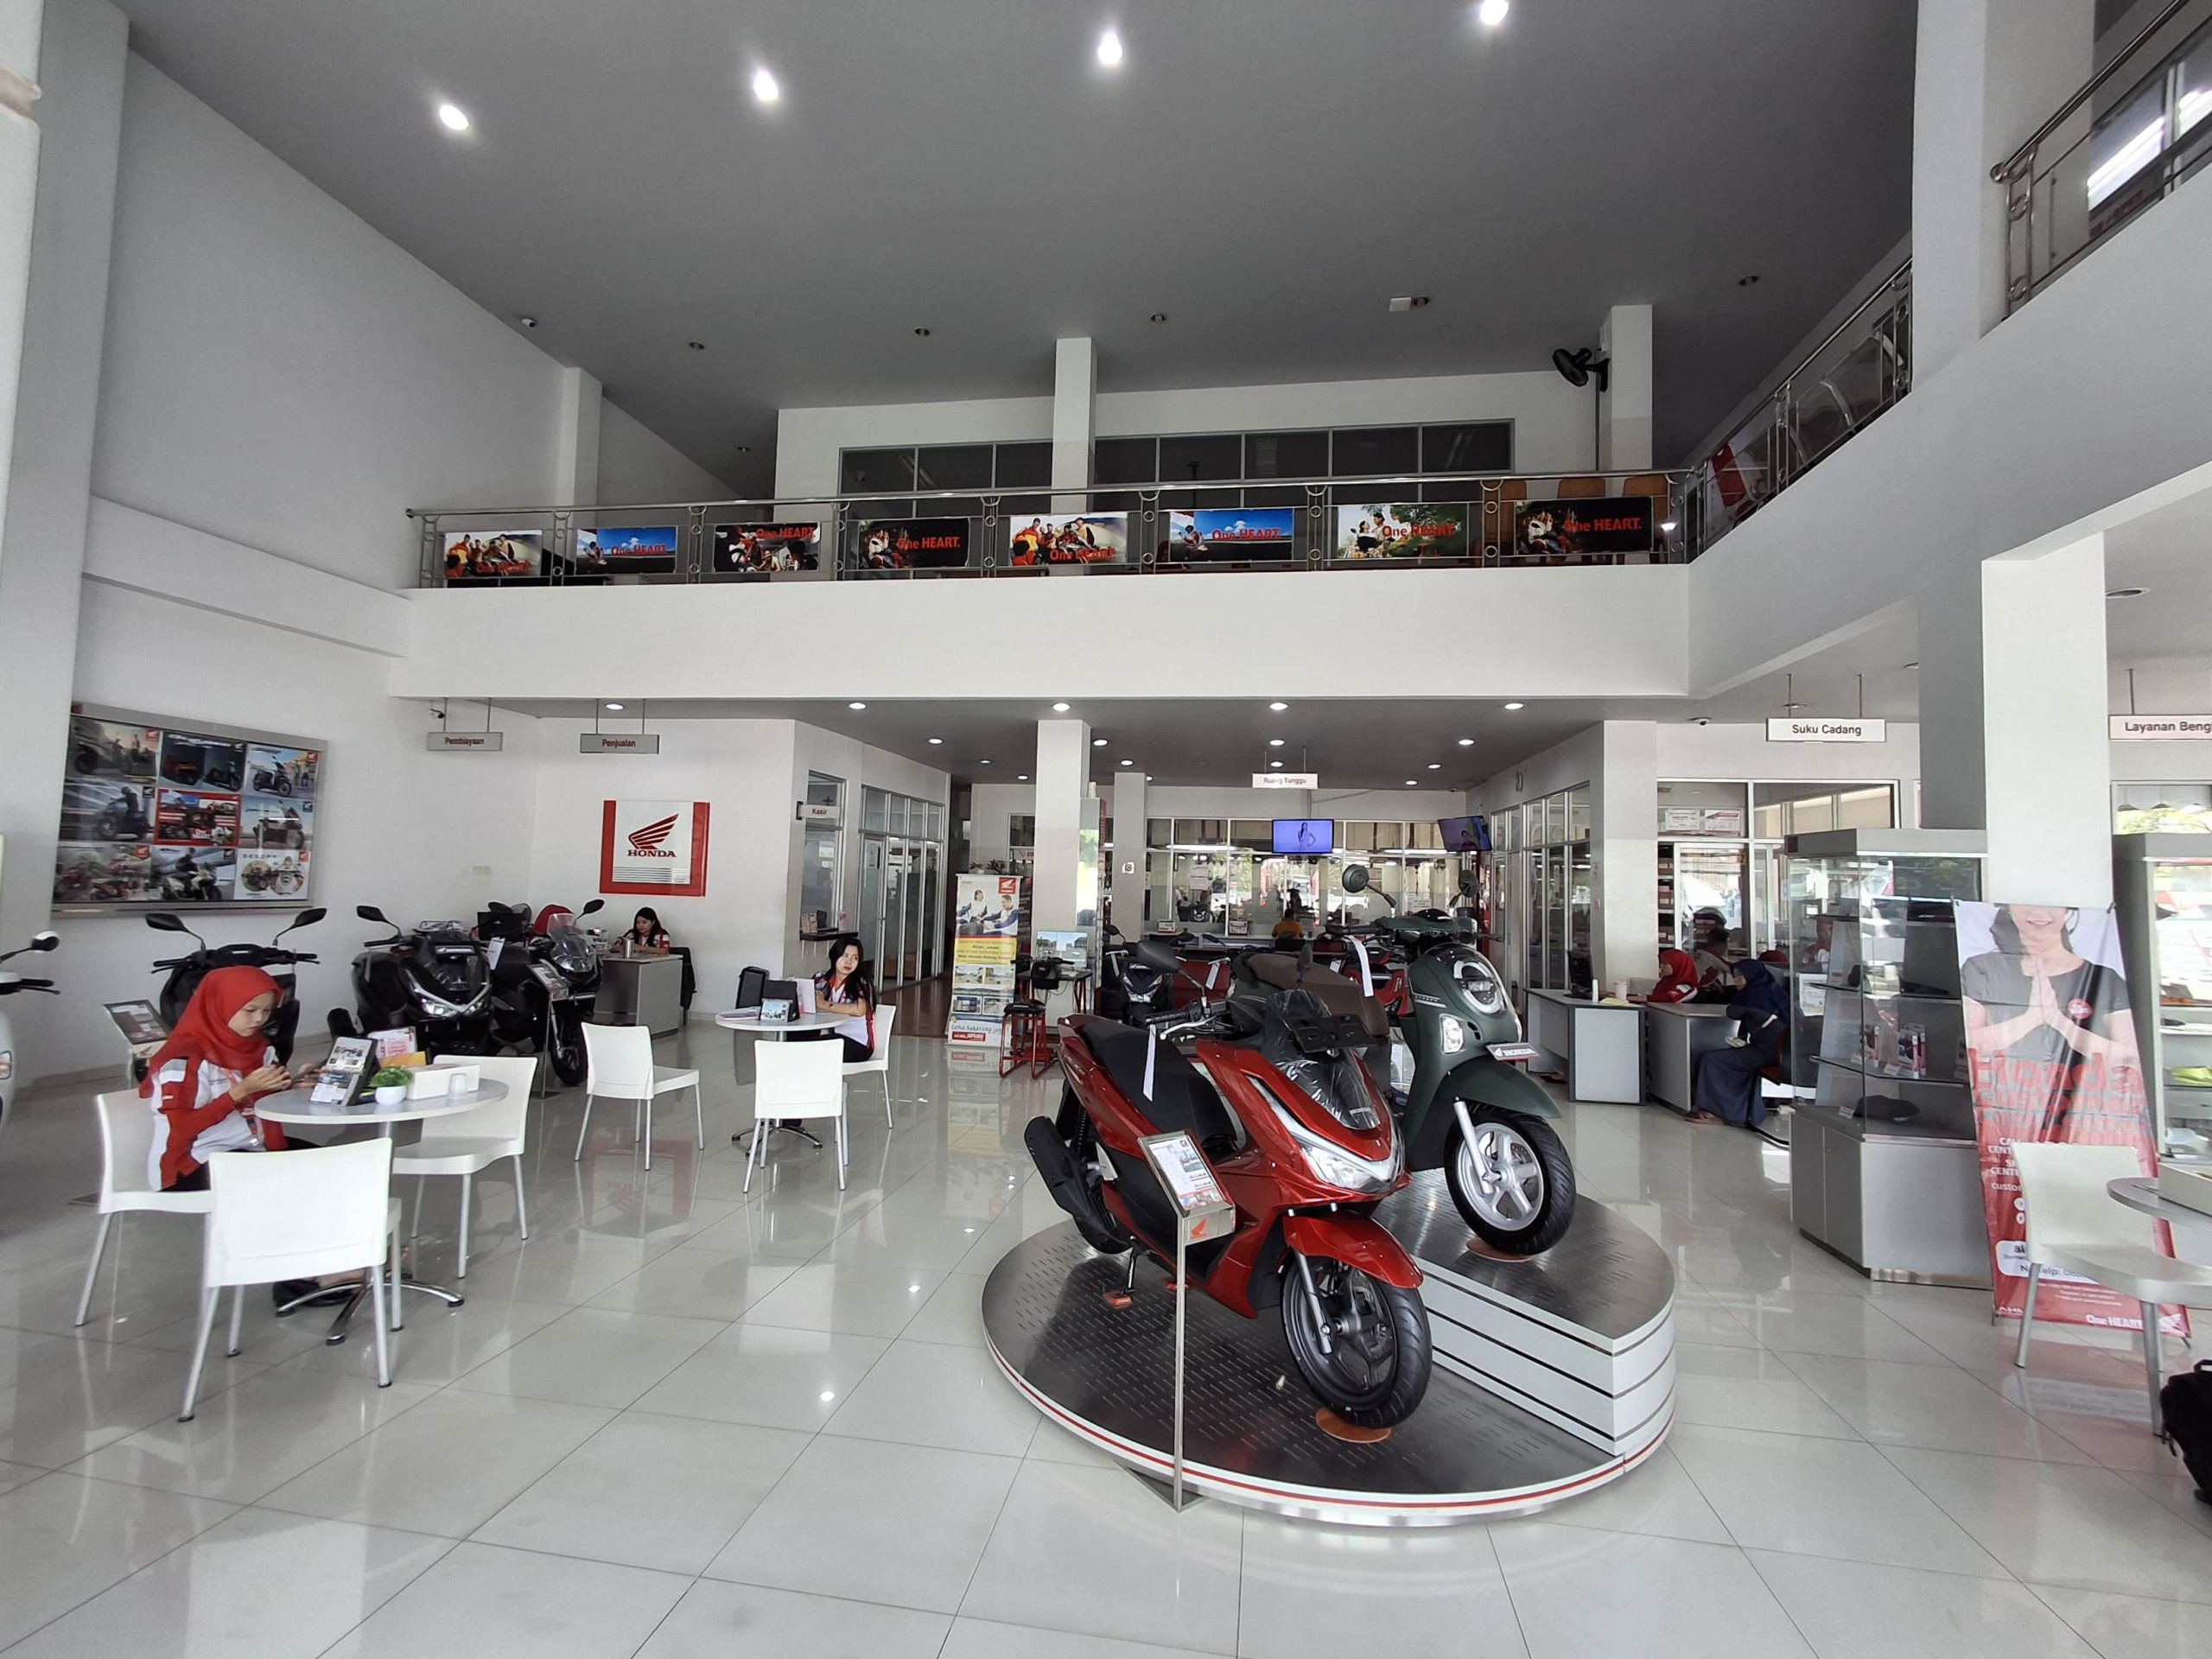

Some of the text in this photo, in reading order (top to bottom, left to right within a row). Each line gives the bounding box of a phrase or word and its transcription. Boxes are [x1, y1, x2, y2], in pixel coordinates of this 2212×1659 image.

[1382, 525, 1408, 537] One
[921, 537, 960, 550] HEART.
[1791, 724, 1862, 737] Suku Cadang
[2125, 721, 2212, 734] Layanan Beng
[602, 739, 636, 748] Penjualan
[627, 849, 677, 858] HONDA
[1967, 1047, 2142, 1094] Honda
[1987, 1145, 2012, 1154] CENT
